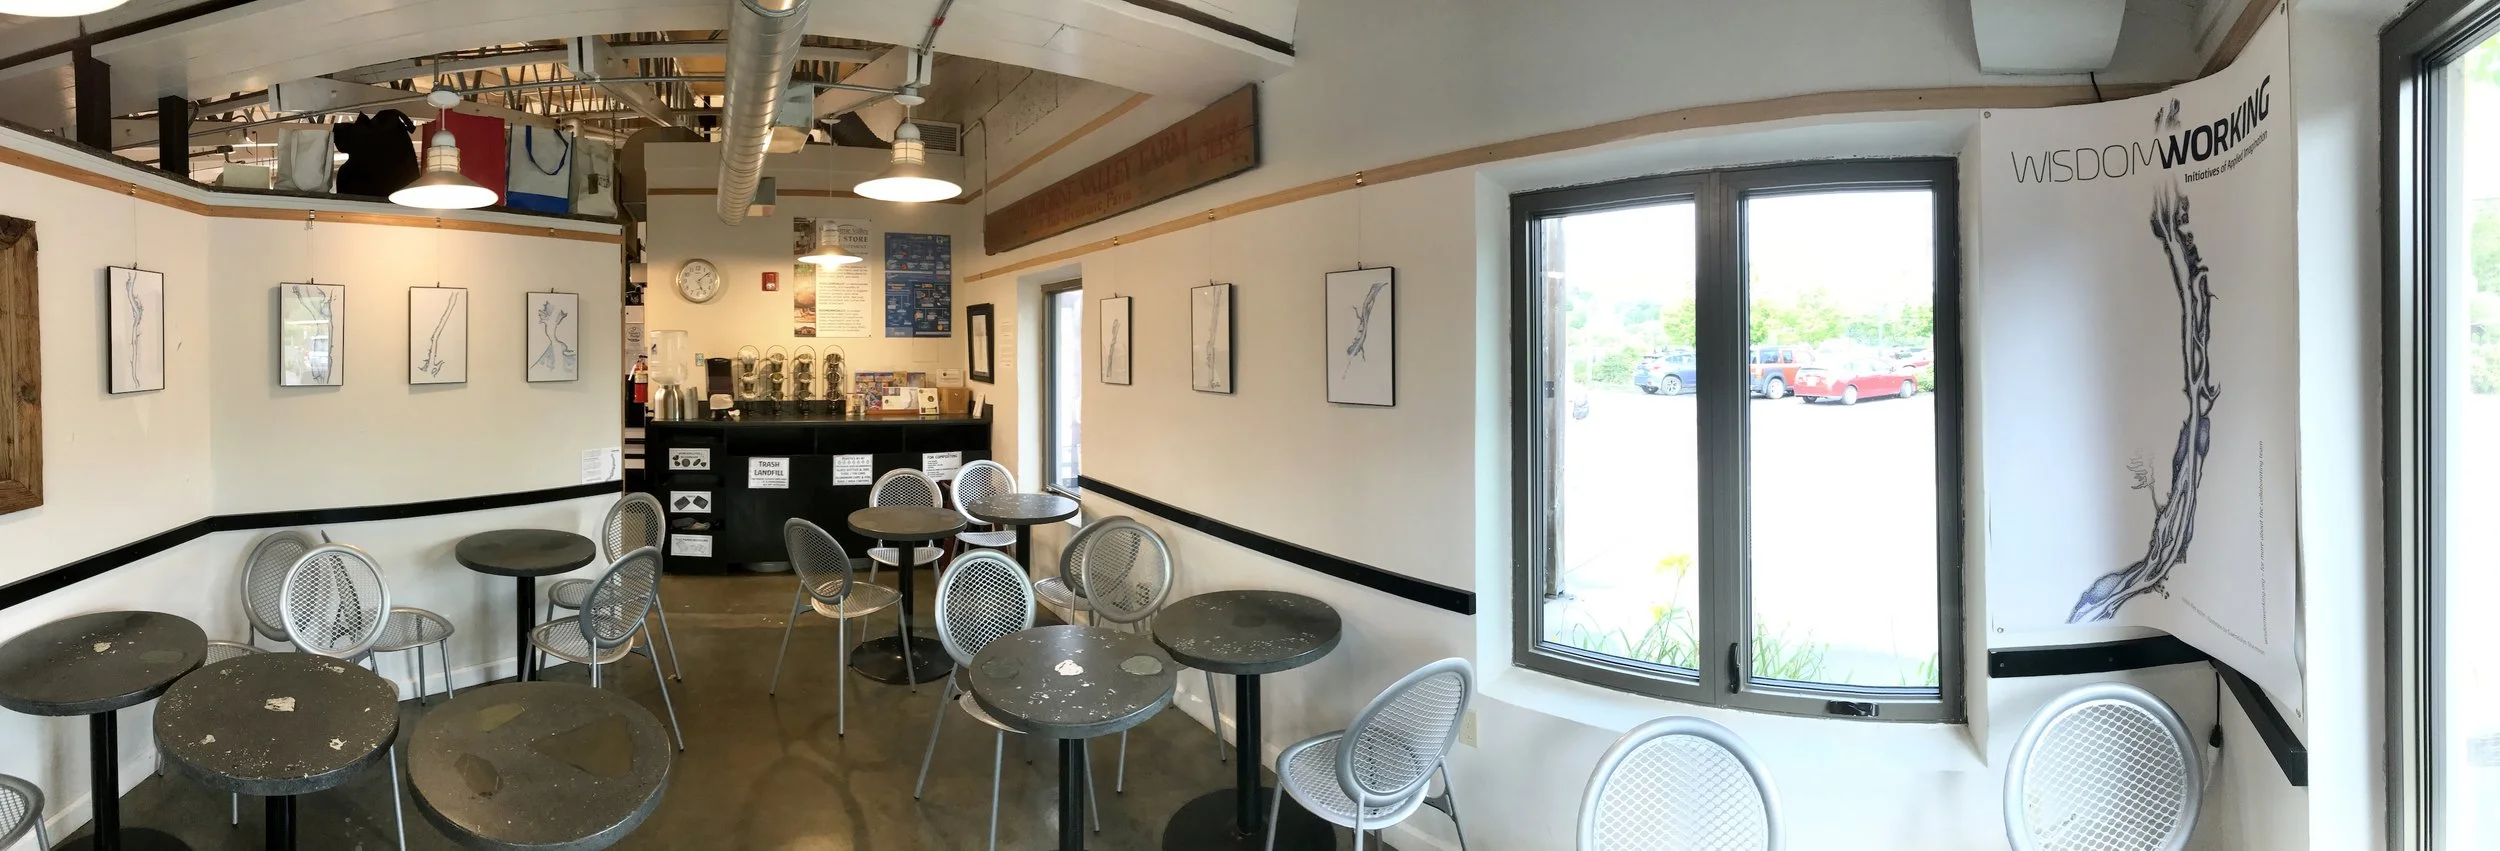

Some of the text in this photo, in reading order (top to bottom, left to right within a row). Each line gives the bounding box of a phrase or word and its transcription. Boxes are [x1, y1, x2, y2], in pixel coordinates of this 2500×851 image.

[2185, 166, 2220, 183] Initiatives
[2220, 161, 2228, 173] of
[2227, 149, 2244, 171] Applied
